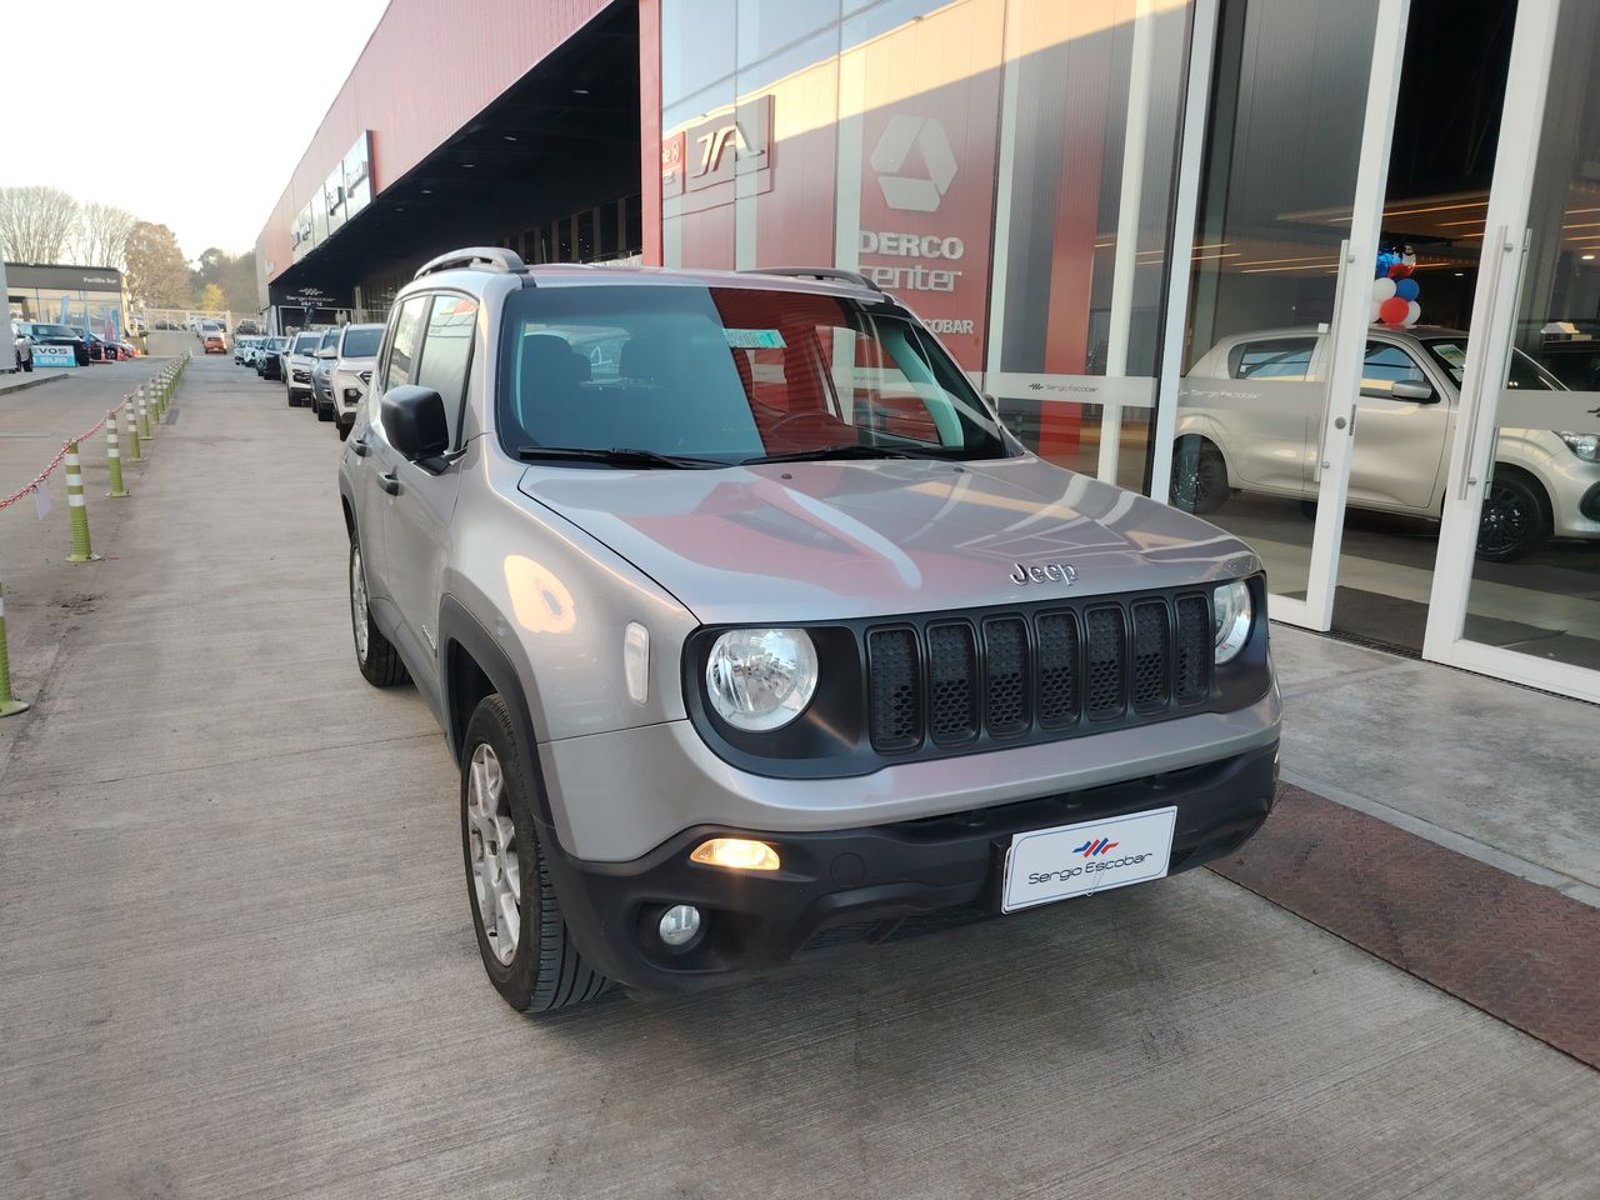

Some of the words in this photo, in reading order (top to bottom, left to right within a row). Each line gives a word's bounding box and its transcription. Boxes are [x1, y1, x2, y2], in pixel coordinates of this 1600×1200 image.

[857, 230, 964, 260] DERCO
[922, 318, 975, 335] COBAR
[1009, 562, 1077, 586] Jeep
[1085, 852, 1153, 874] Escobar
